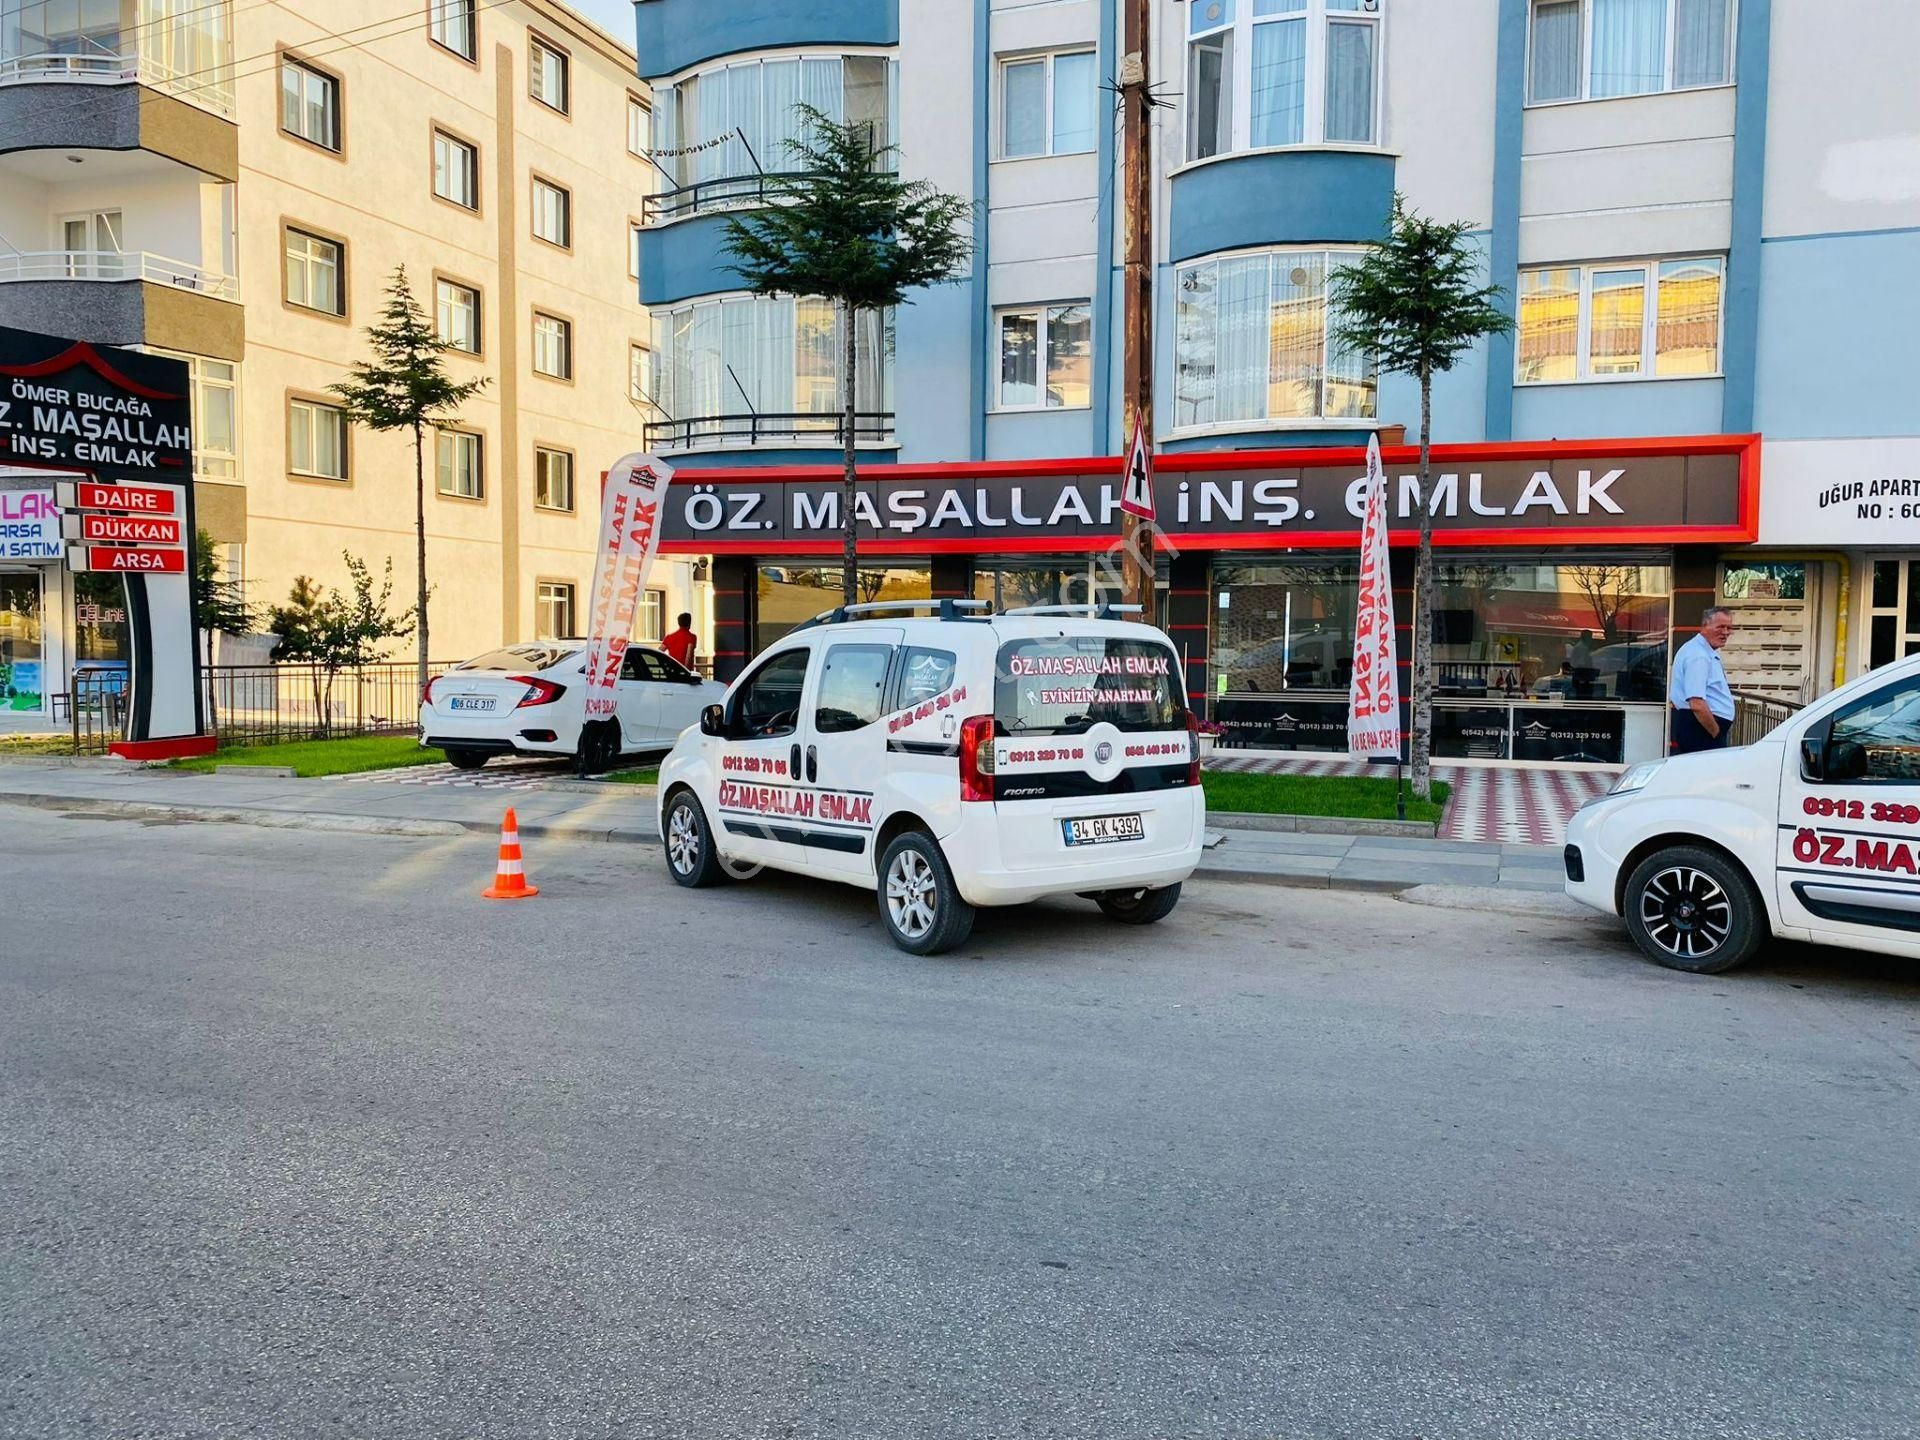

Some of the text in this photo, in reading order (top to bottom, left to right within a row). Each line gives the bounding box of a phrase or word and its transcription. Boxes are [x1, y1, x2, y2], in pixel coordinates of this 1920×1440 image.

[12, 378, 152, 417] ÖMER BUCAĞA
[33, 406, 190, 450] MAŞALLAH
[74, 443, 156, 468] EMLAK
[94, 488, 157, 509] DAİRE
[684, 484, 774, 530] ÖZ.
[1345, 469, 1626, 519] EMLAK
[1819, 482, 1864, 509] UĞUR
[1857, 503, 1882, 519] NO
[92, 519, 174, 540] DÜKKAN
[10, 542, 60, 557] SATIM
[112, 552, 165, 569] ARSA
[1010, 655, 1170, 677] ÖZ.MAŞALLAH EMLAK
[466, 699, 478, 709] CLE
[481, 700, 495, 709] 317
[1041, 686, 1152, 704] EVİNİZİN ANAHTARI
[1550, 732, 1574, 740] 0(312)
[719, 780, 873, 824] ÖZ.MAŞALLAH EMLAK
[1803, 796, 1920, 824] 0312 329
[1072, 816, 1140, 838] 34 GK 4392
[1793, 828, 1920, 875] ÖZ.MA
